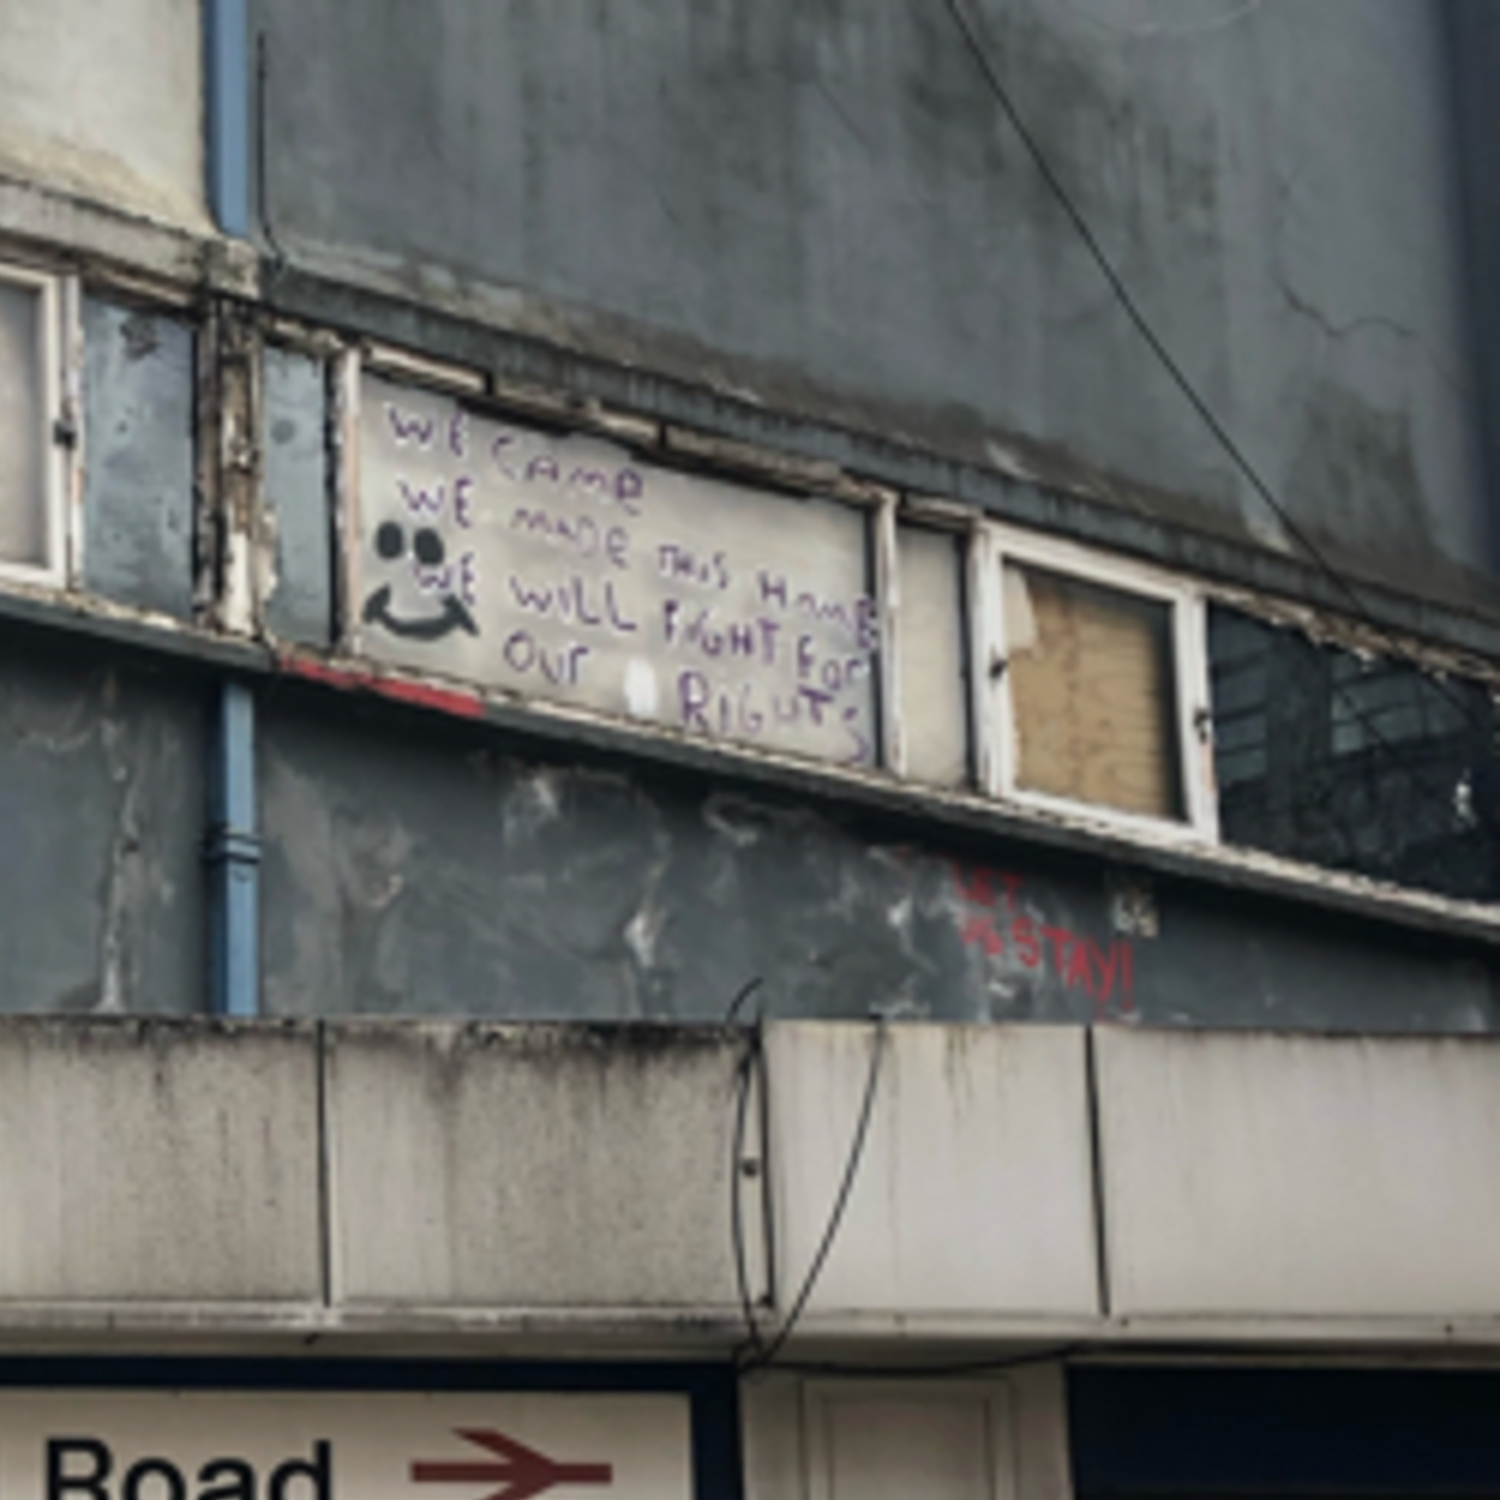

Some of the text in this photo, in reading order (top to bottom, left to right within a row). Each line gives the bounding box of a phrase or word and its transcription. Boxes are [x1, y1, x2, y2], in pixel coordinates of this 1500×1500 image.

[388, 406, 644, 518] WE CAME
[398, 478, 474, 528] WE
[510, 507, 630, 571] MADE
[412, 552, 476, 606] WE
[510, 576, 638, 634] WILL
[1011, 914, 1135, 1020] STAY!
